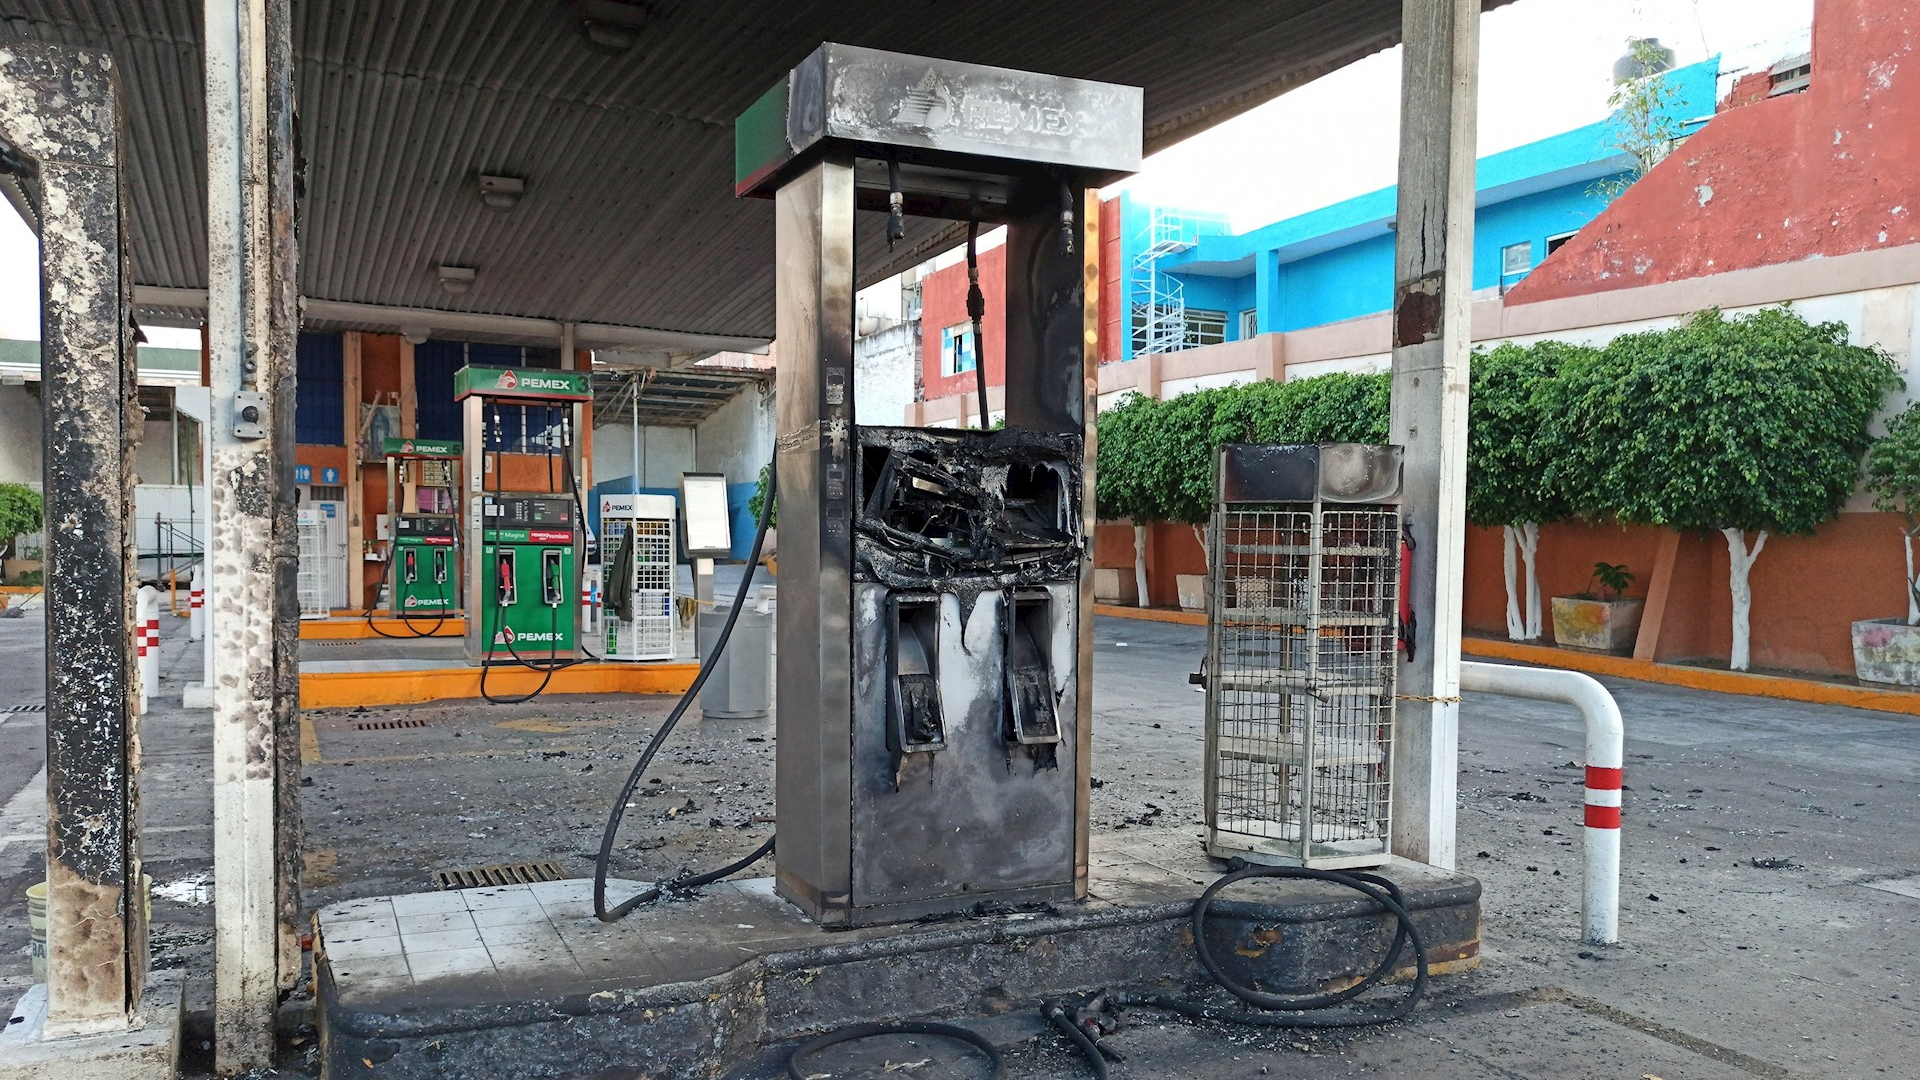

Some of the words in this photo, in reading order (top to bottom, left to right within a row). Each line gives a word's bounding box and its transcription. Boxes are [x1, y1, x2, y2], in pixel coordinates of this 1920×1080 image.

[521, 377, 570, 390] PEMEX
[577, 376, 590, 394] 3
[416, 445, 447, 453] PEMEX
[452, 444, 461, 455] 5
[504, 532, 525, 540] Magna
[417, 598, 449, 606] PEMEX
[517, 632, 564, 641] PEMEX
